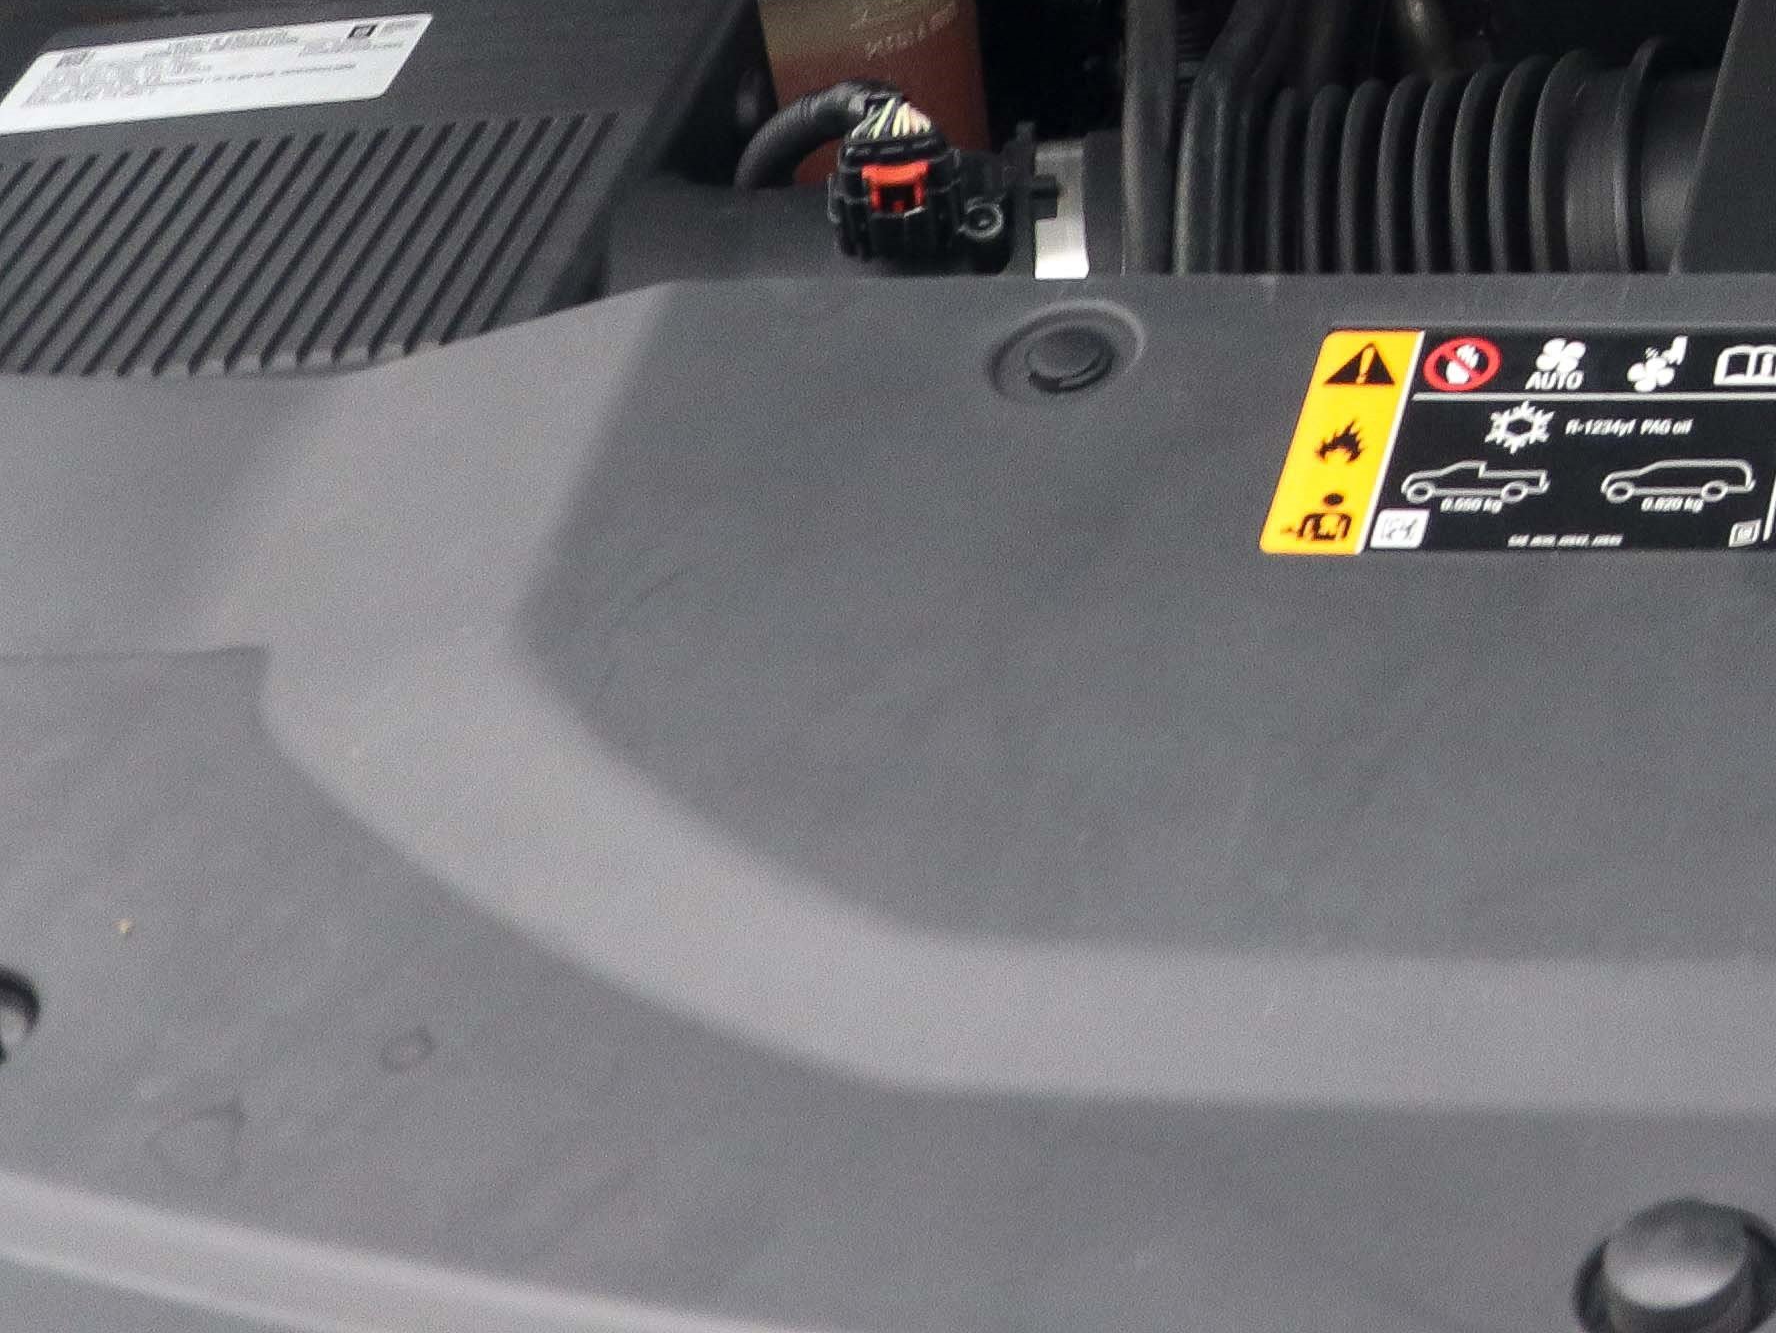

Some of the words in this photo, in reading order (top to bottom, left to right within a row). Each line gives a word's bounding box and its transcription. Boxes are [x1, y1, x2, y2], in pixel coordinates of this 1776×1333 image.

[1525, 370, 1584, 391] AUTO
[1640, 418, 1673, 435] PAG
[1684, 497, 1704, 513] kg
